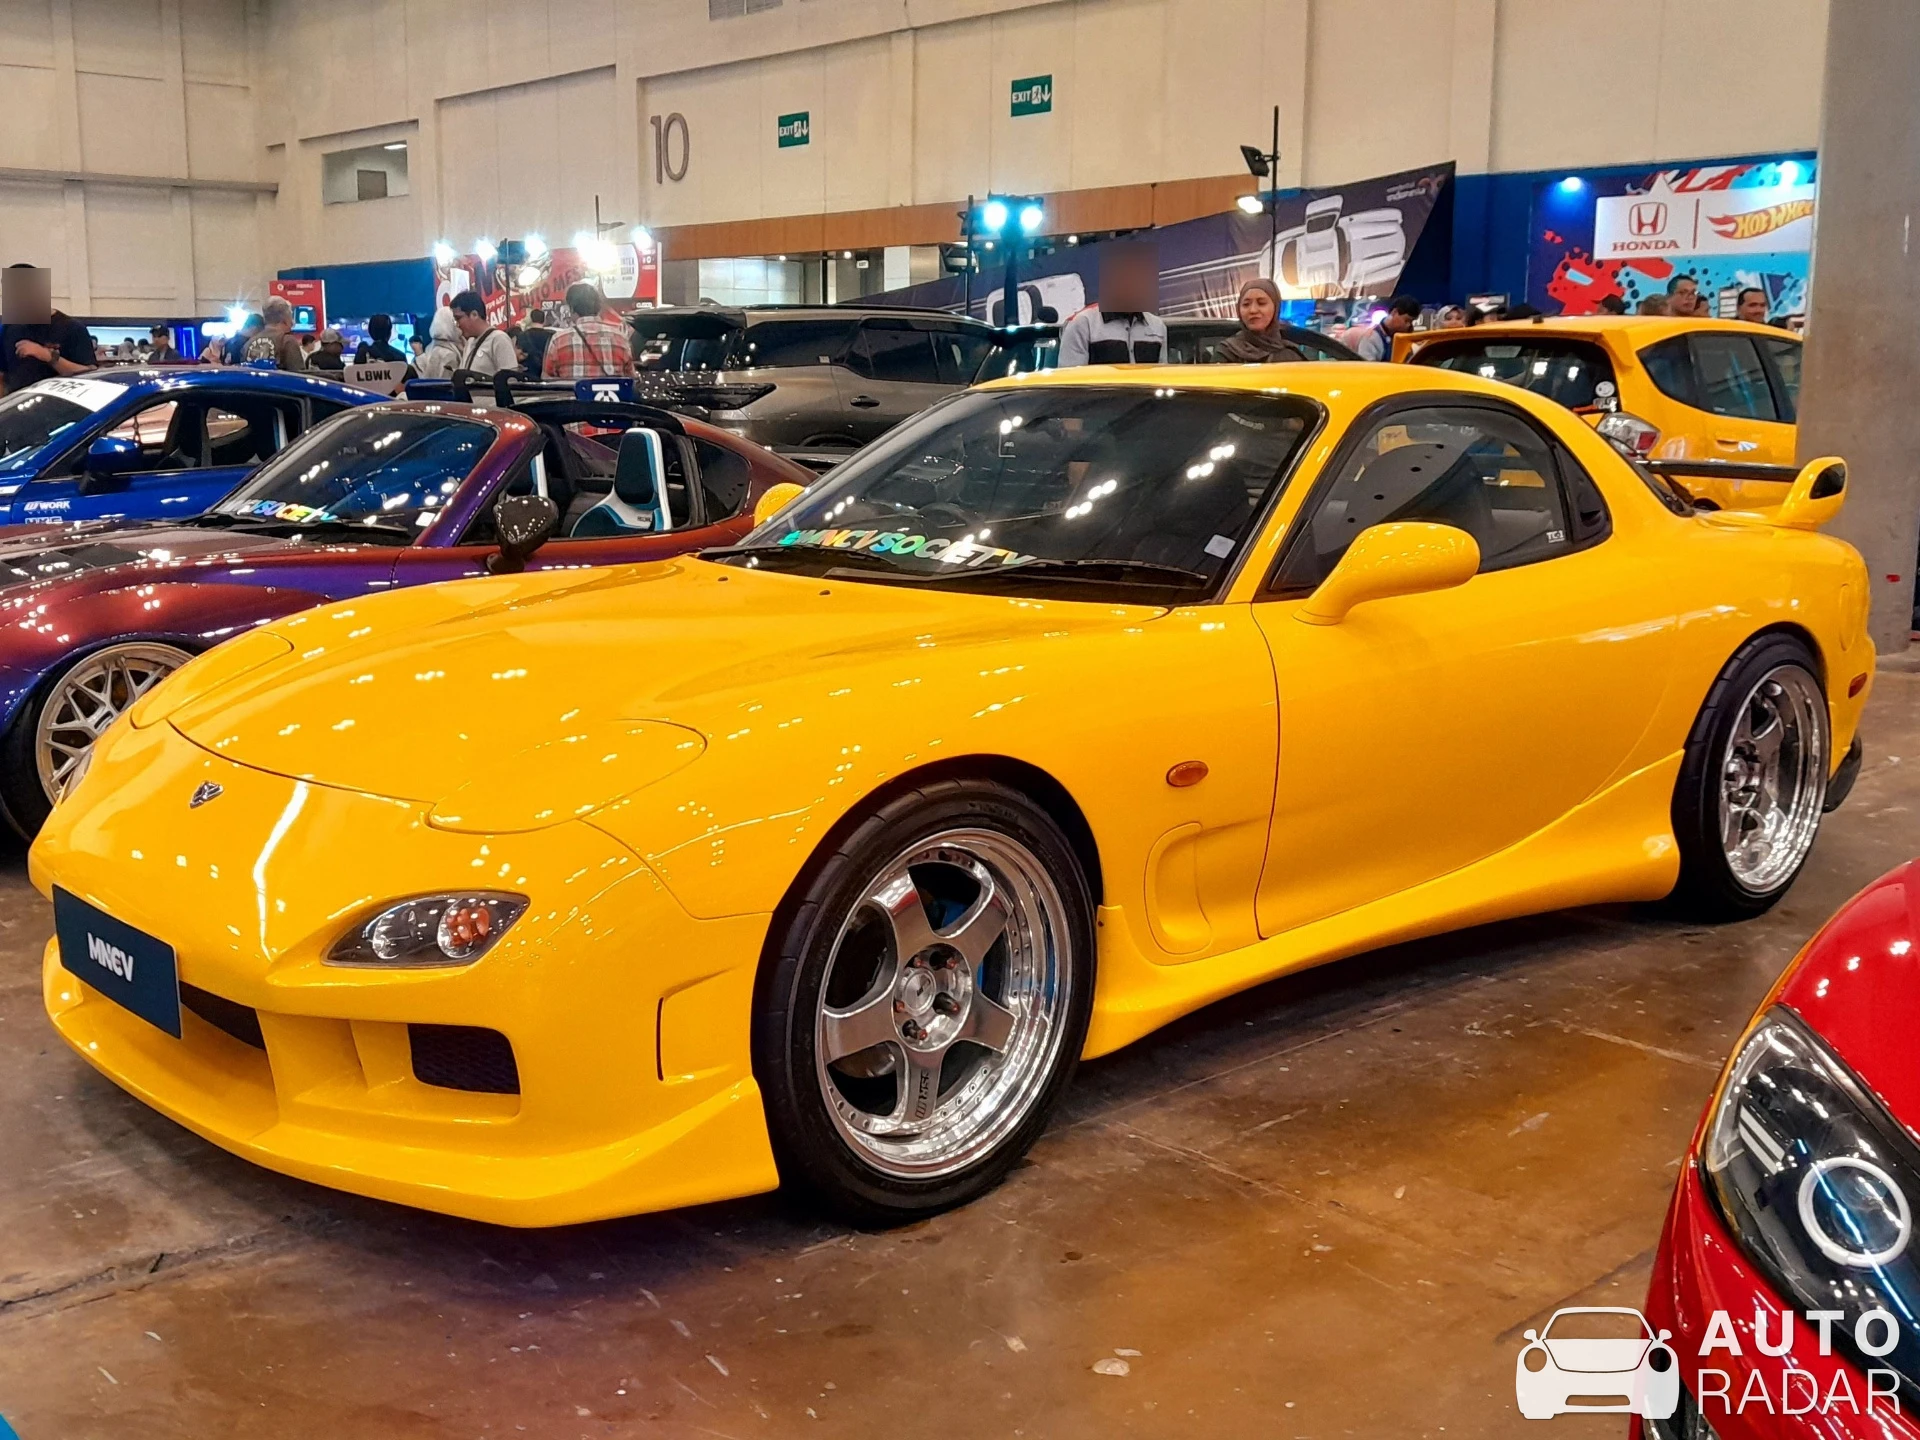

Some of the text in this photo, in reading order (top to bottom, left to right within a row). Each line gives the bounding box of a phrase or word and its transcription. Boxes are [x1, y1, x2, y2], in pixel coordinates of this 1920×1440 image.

[1012, 90, 1031, 103] EXIT
[779, 125, 794, 137] EXIT
[650, 112, 690, 184] 10
[1612, 239, 1680, 252] HONDA
[356, 370, 392, 382] LBWK
[40, 500, 71, 510] WORK
